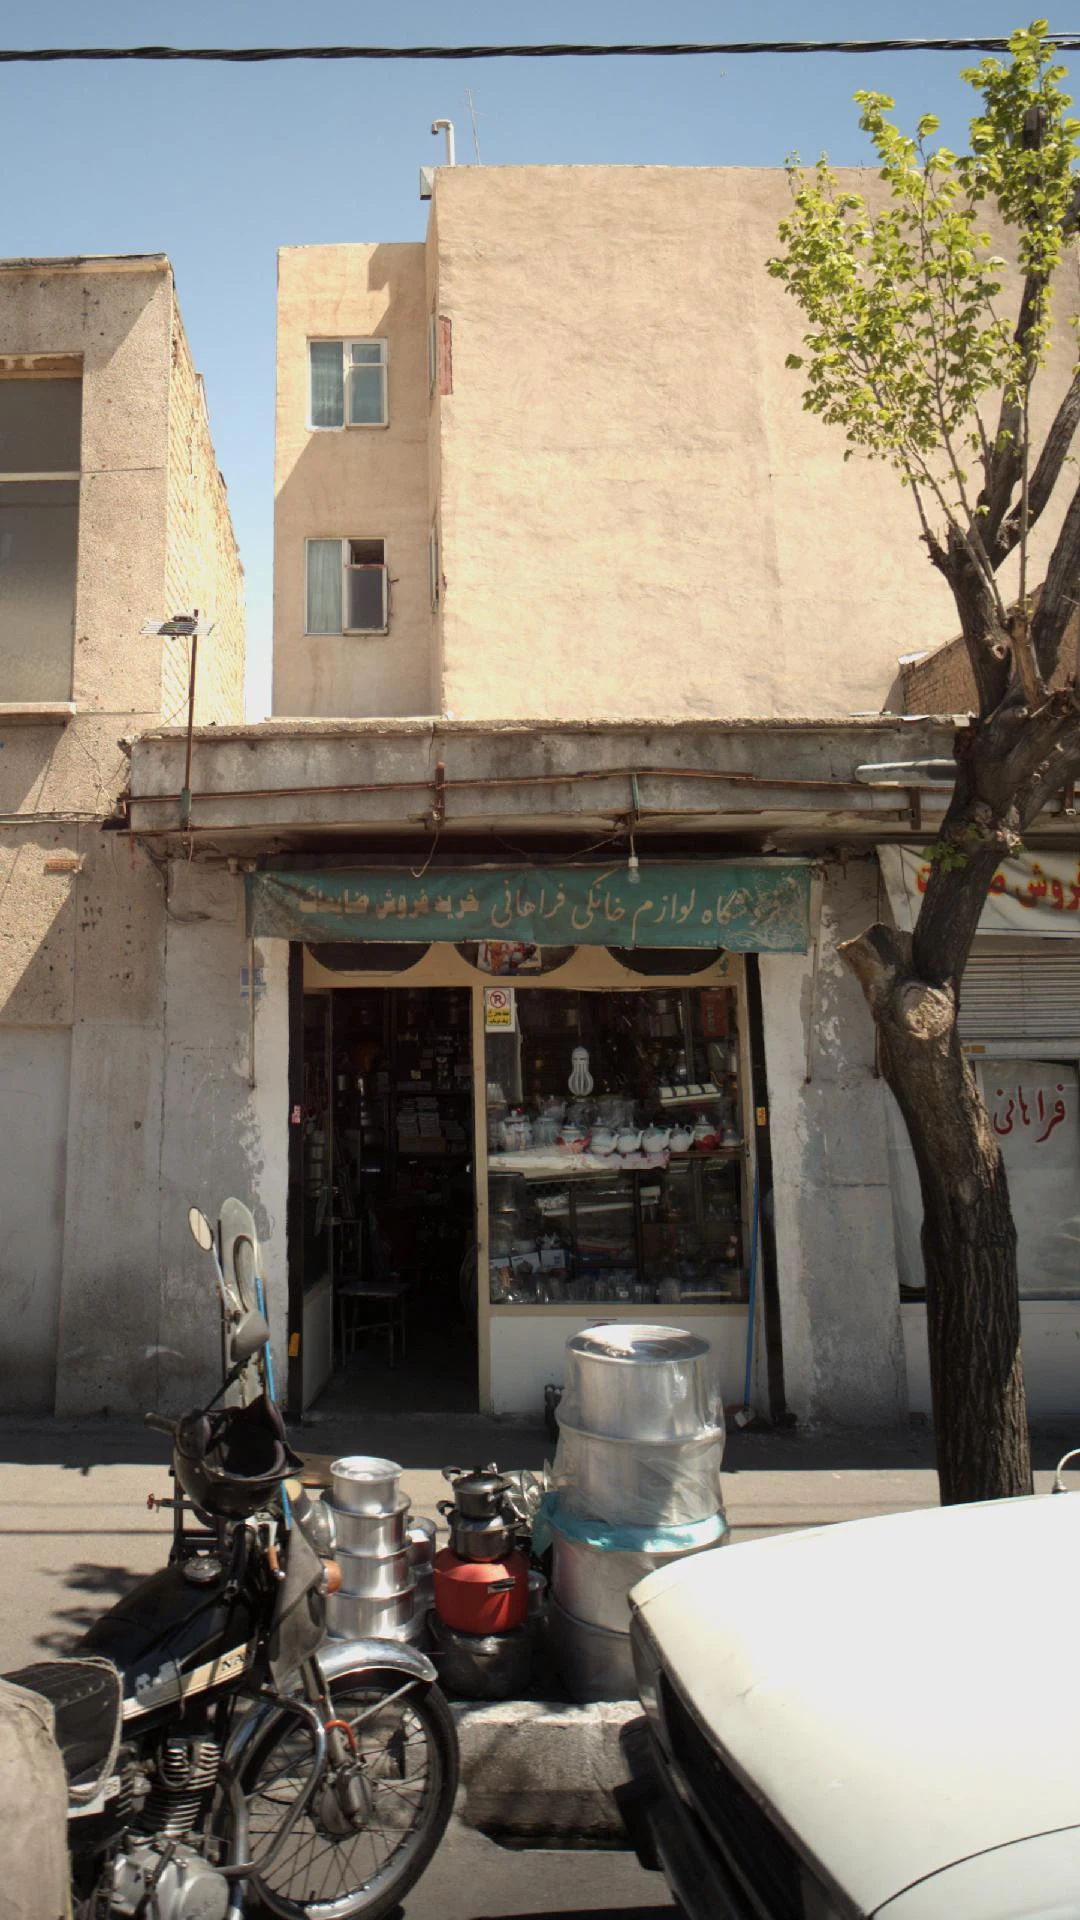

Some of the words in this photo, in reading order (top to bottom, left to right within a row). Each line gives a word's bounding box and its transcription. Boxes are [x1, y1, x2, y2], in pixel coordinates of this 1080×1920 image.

[375, 888, 430, 920] فروش
[434, 887, 480, 920] خرید
[491, 879, 566, 929] فراهانی
[571, 867, 626, 930] خانگی
[631, 888, 696, 945] لوازم
[993, 1083, 1066, 1143] فراهانی
